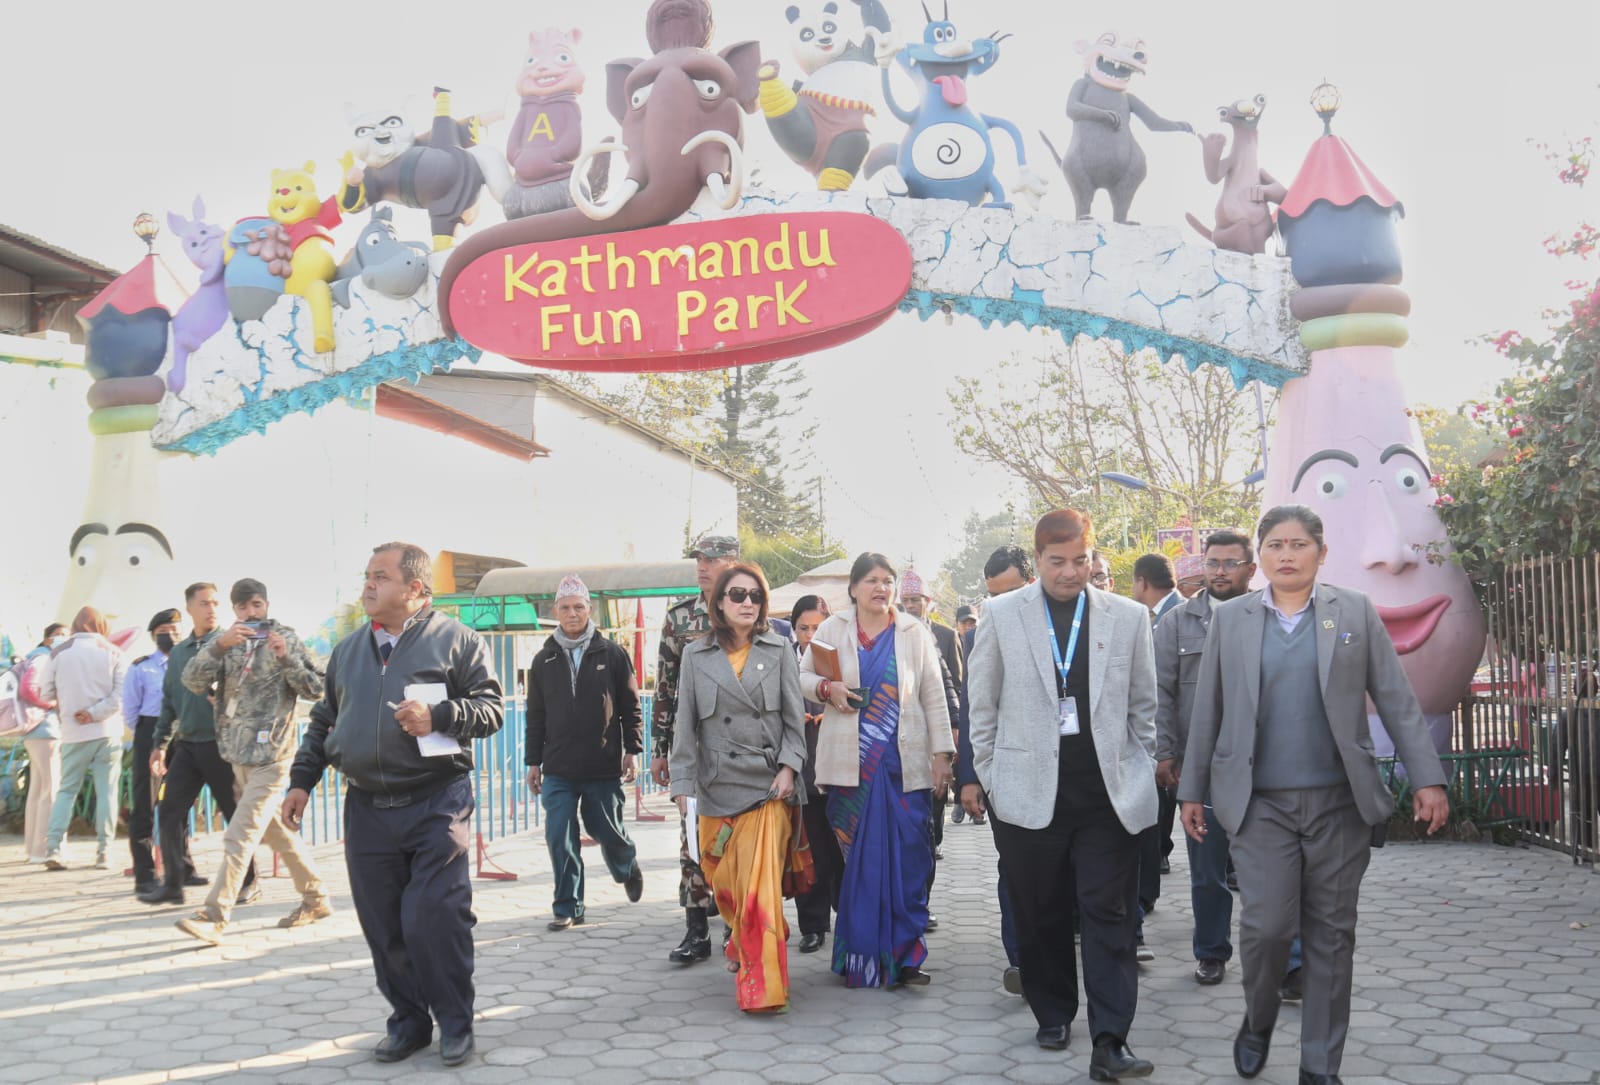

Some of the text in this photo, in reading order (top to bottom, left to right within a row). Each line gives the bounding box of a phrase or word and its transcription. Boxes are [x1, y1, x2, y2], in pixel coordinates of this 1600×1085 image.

[527, 112, 555, 142] A
[503, 221, 838, 302] Kathmandu
[540, 303, 643, 351] Fun
